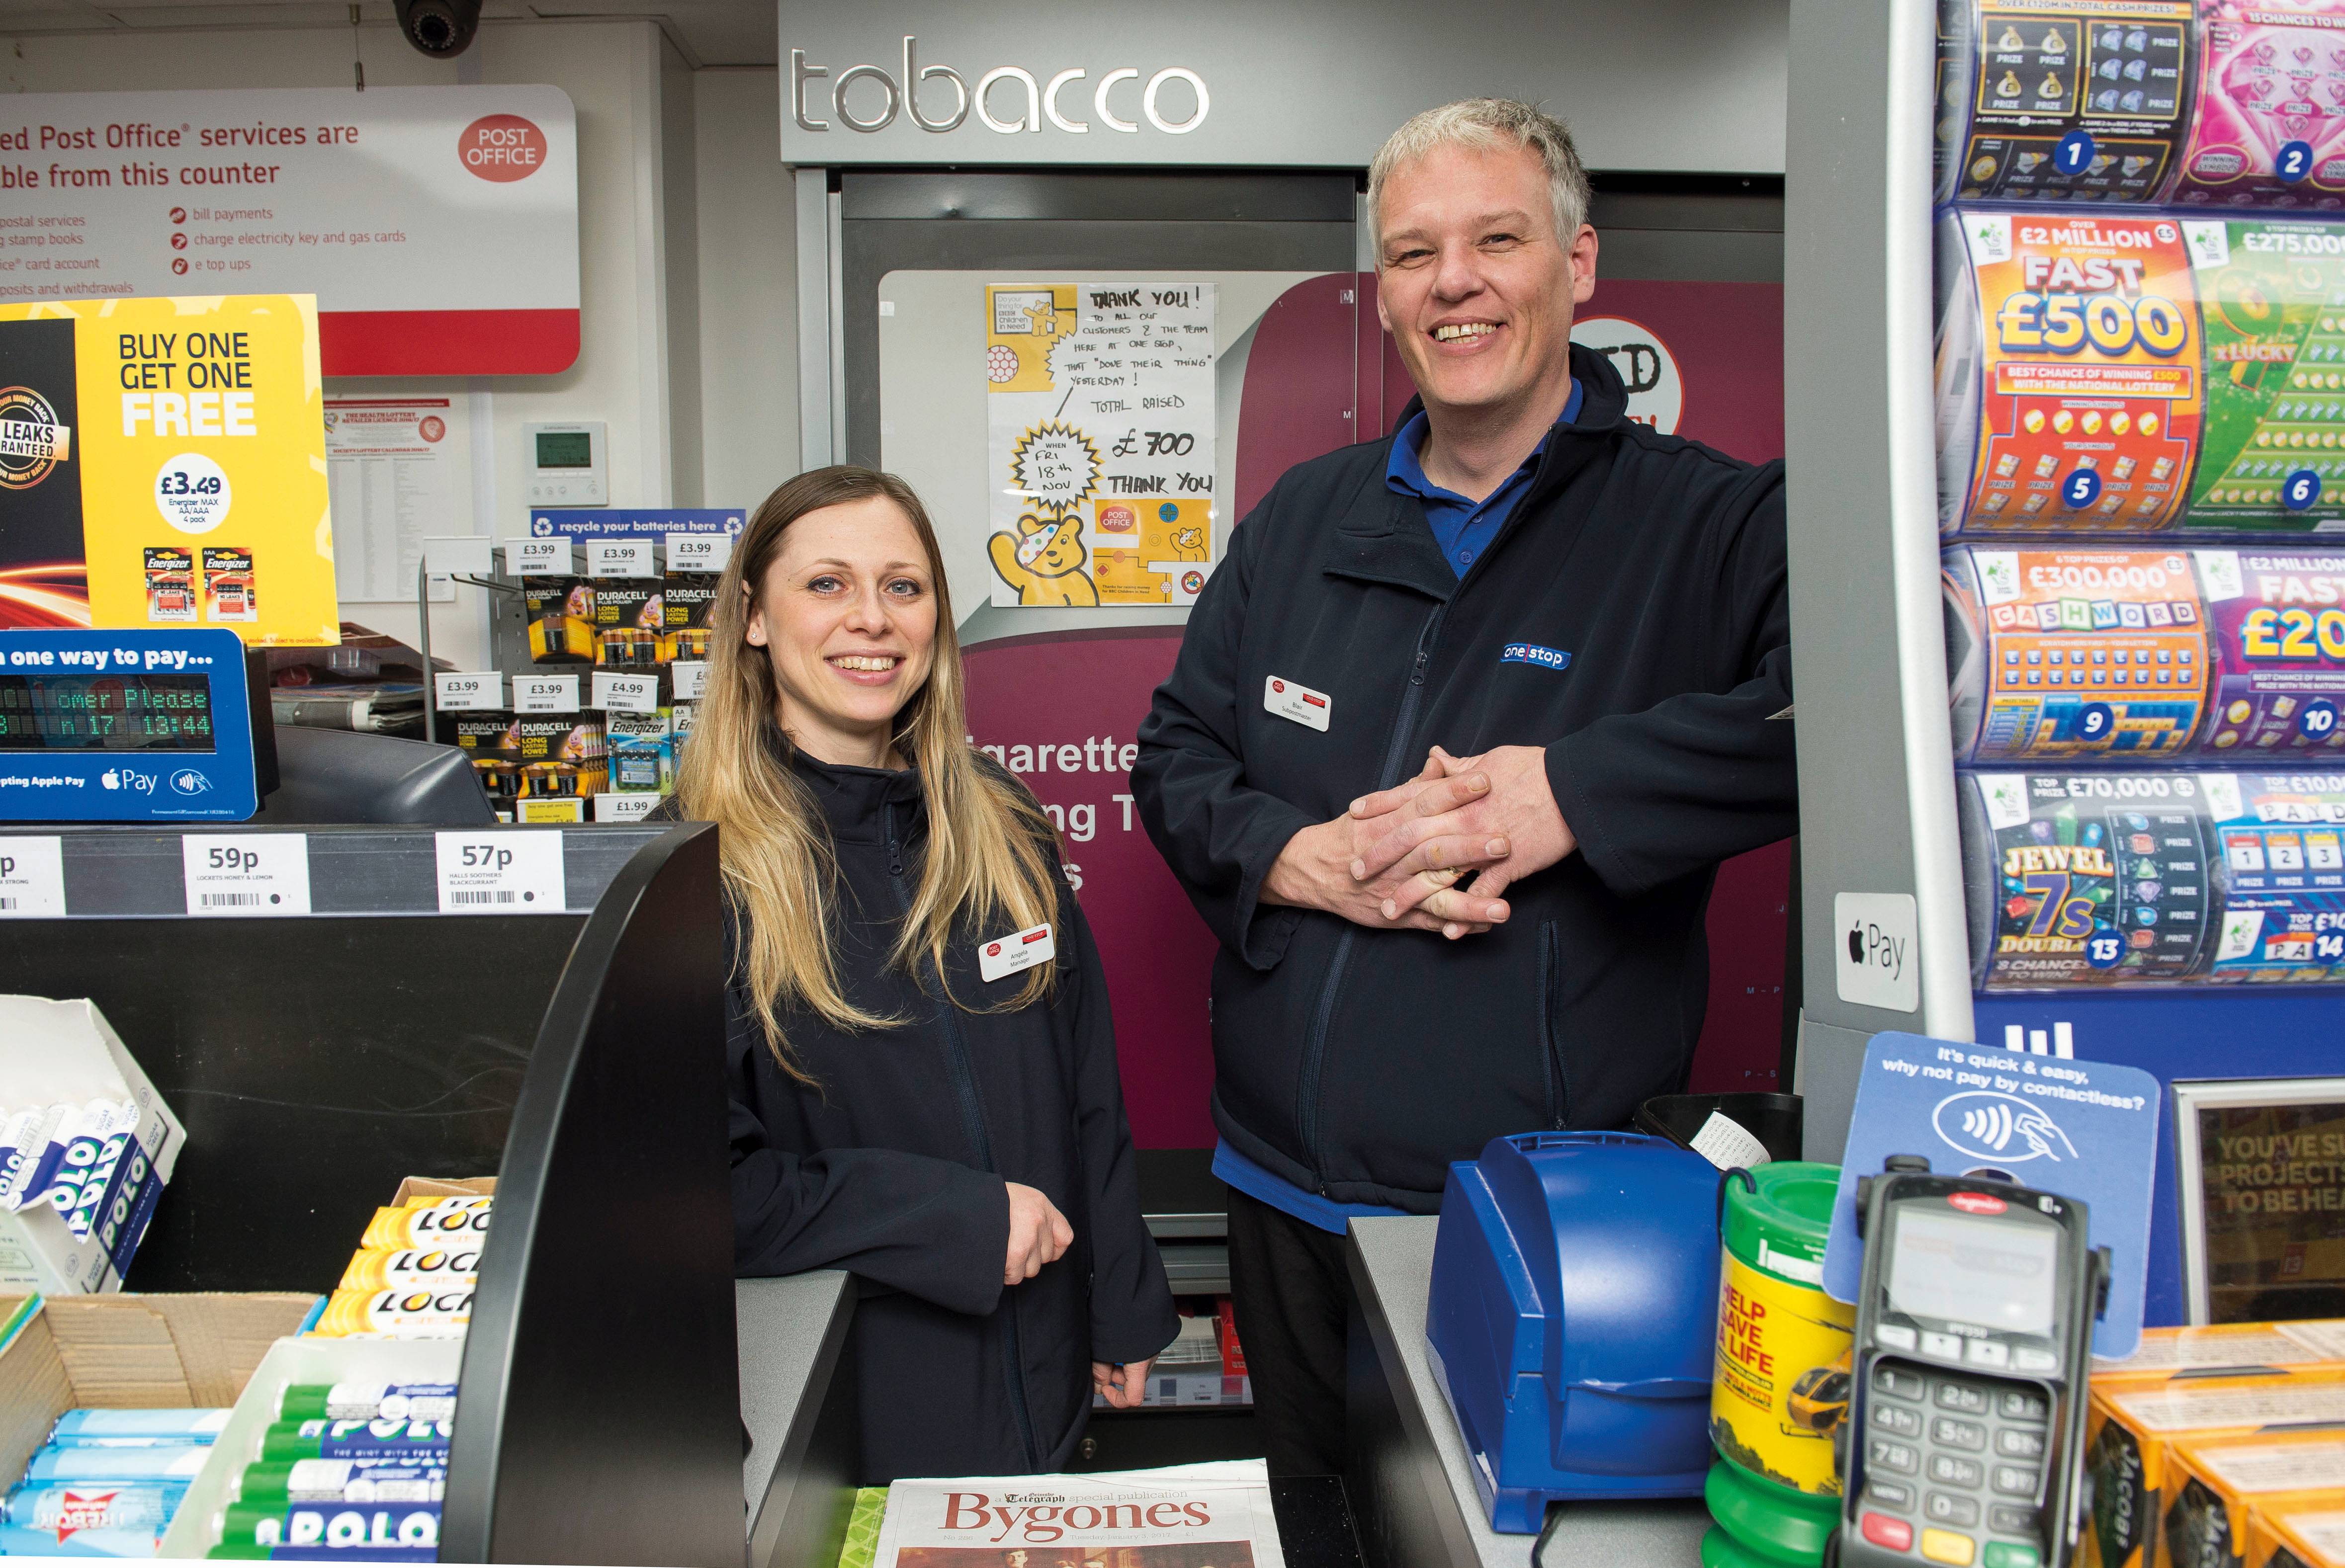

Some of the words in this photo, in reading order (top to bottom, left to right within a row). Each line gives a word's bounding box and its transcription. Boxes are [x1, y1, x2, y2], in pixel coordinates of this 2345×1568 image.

[792, 35, 1210, 135] tobacco
[41, 126, 96, 149] Post
[201, 121, 306, 146] services
[317, 125, 359, 144] are
[478, 128, 528, 146] POST
[467, 147, 536, 166] OFFICE
[2069, 143, 2081, 165] 1
[2285, 151, 2303, 173] 2
[1, 165, 39, 188] ble
[48, 163, 110, 188] from
[121, 162, 169, 186] this
[179, 162, 279, 185] counter
[38, 215, 87, 227] services
[193, 209, 211, 220] bill
[215, 209, 273, 222] payments
[8, 234, 45, 248] stamp
[49, 233, 84, 245] books
[194, 234, 234, 247] charge
[239, 232, 294, 246] electricity
[298, 231, 319, 246] key
[323, 231, 345, 243] and
[349, 234, 370, 246] gas
[374, 231, 406, 243] cards
[2020, 227, 2048, 245] £2
[2053, 228, 2152, 248] MILLION
[25, 258, 50, 270] card
[54, 258, 99, 270] account
[2025, 256, 2143, 288] FAST
[38, 283, 60, 295] and
[63, 282, 133, 294] withdrawals
[1090, 288, 1143, 309] THANK
[1183, 325, 1208, 333] TEAM
[1998, 293, 2186, 354] £500
[119, 333, 177, 359] BUY
[186, 332, 249, 358] ONE
[1074, 343, 1097, 352] HERE
[120, 363, 176, 389] GET
[187, 362, 253, 388] ONE
[2008, 367, 2037, 377] BEST
[2038, 368, 2085, 378] CHANCE
[2102, 370, 2152, 380] WINNING
[2013, 380, 2043, 389] WITH
[2045, 380, 2066, 389] THE
[2068, 381, 2122, 391] NATIONAL
[2123, 382, 2176, 392] LOTTERY
[121, 391, 257, 436] FREE
[1091, 400, 1131, 413] TOTAL
[1036, 450, 1058, 460] FRI
[161, 472, 221, 495] £3.49
[1042, 481, 1070, 491] NOV
[1108, 475, 1169, 494] THANK
[1177, 472, 1213, 493] YOU
[2073, 478, 2089, 499] 5
[2292, 480, 2310, 500] 6
[169, 498, 197, 508] Energizer
[559, 521, 601, 533] recycle
[604, 523, 631, 533] your
[634, 520, 686, 532] batteries
[689, 521, 716, 531] here
[523, 545, 555, 555] £3.99
[604, 549, 635, 559] £3.99
[680, 543, 711, 553] £3.99
[147, 558, 190, 570] Energizer
[206, 558, 250, 570] Energizer
[2028, 566, 2166, 589] £300,000
[526, 589, 562, 598] DURACELL
[597, 591, 647, 601] DURACELL
[666, 589, 716, 599] DURACELL
[1995, 600, 2193, 627] CASHWORD
[11, 651, 54, 665] one
[59, 651, 109, 669] way
[113, 649, 138, 665] to
[1504, 647, 1525, 658] one
[1529, 648, 1563, 666] stop
[448, 681, 478, 691] £3.99
[531, 684, 562, 694] £3.99
[612, 683, 643, 693] £4.99
[125, 689, 207, 709] Please
[1282, 706, 1311, 721] Subpostmaster
[2084, 712, 2103, 732] 9
[2306, 710, 2333, 731] 10
[91, 716, 114, 735] 17
[145, 716, 210, 735] 13:44
[458, 722, 509, 732] DURACELL
[521, 722, 572, 732] DURACELL
[611, 721, 665, 735] Energizer
[31, 776, 63, 788] Apple
[66, 777, 85, 788] Pay
[123, 769, 157, 795] Pay
[2036, 779, 2058, 788] TOP
[2067, 777, 2169, 799] £70,000
[2033, 788, 2066, 797] PRIZE
[617, 802, 647, 811] £1.99
[209, 848, 258, 873] 59p
[462, 845, 512, 870] 57p
[2003, 846, 2114, 877] JEWEL
[1011, 950, 1028, 959] Angela
[1870, 924, 1905, 981] Pay
[2091, 939, 2118, 960] 13
[2317, 936, 2343, 956] 14
[1010, 957, 1030, 967] Manager
[1937, 1048, 1964, 1063] It's
[1968, 1055, 2018, 1072] quick
[2023, 1061, 2036, 1074] &
[1882, 1059, 1919, 1076] why
[1922, 1066, 1953, 1080] not
[1956, 1071, 1992, 1089] pay
[1995, 1075, 2018, 1093] by
[2022, 1083, 2145, 1111] contactless?
[146, 1122, 159, 1147] SUGAR
[102, 1155, 148, 1250] POLO
[1725, 1283, 1766, 1320] HELP
[1722, 1302, 1762, 1347] SAVE
[1730, 1334, 1774, 1375] LIFE
[1005, 1492, 1065, 1504] Telegraph
[1069, 1492, 1114, 1503] special
[1118, 1489, 1188, 1502] publication
[938, 1492, 1211, 1543] Bygones
[289, 1511, 437, 1546] POLO
